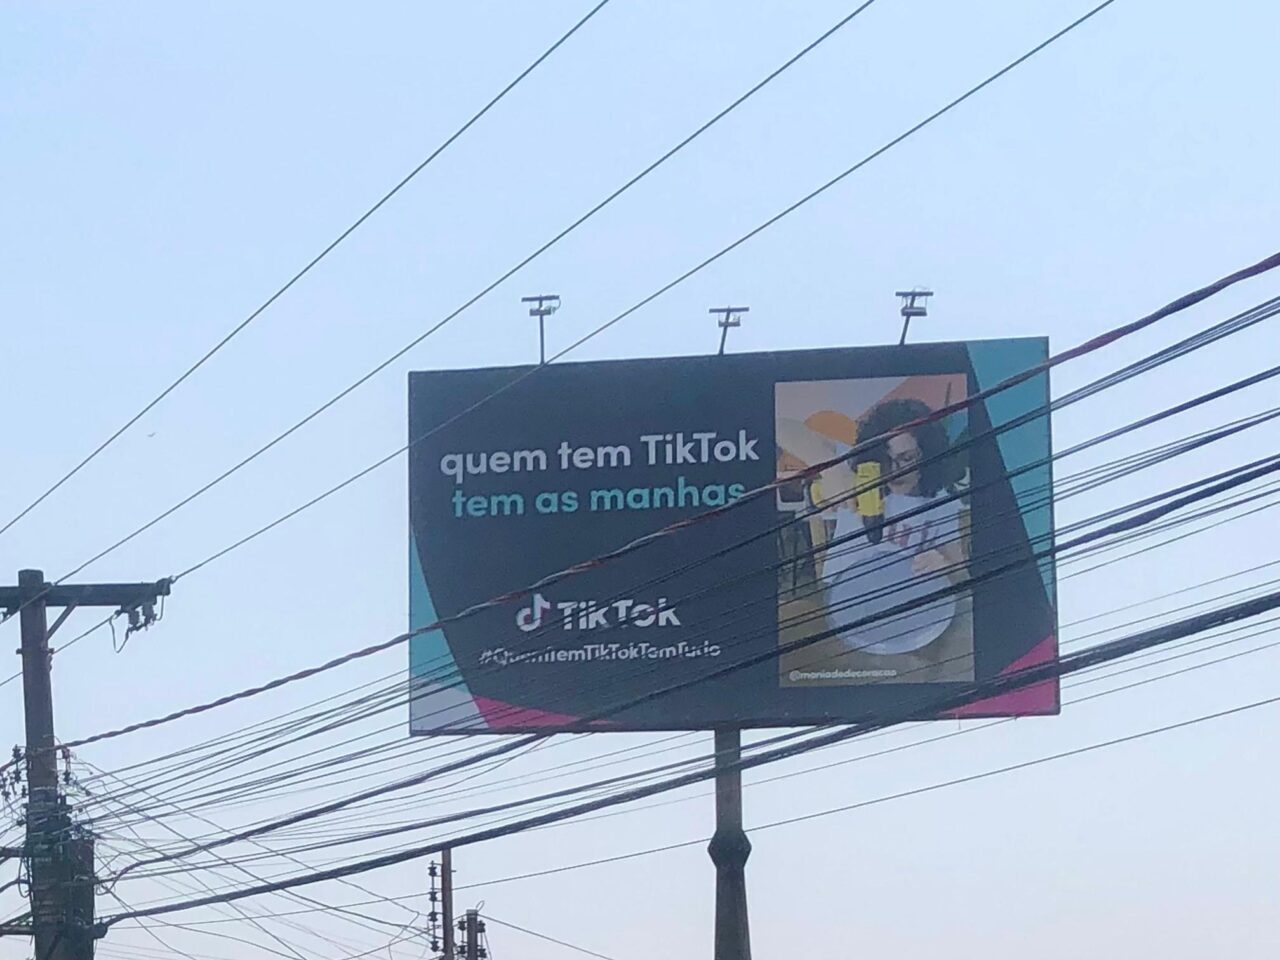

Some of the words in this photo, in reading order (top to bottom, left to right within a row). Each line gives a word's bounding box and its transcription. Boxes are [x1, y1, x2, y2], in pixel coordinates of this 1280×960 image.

[440, 449, 547, 484] quem
[558, 441, 631, 470] tem
[640, 430, 759, 465] TikTok
[451, 489, 524, 518] tem
[535, 490, 579, 513] as
[590, 476, 746, 511] manhas
[557, 597, 681, 630] TikTok
